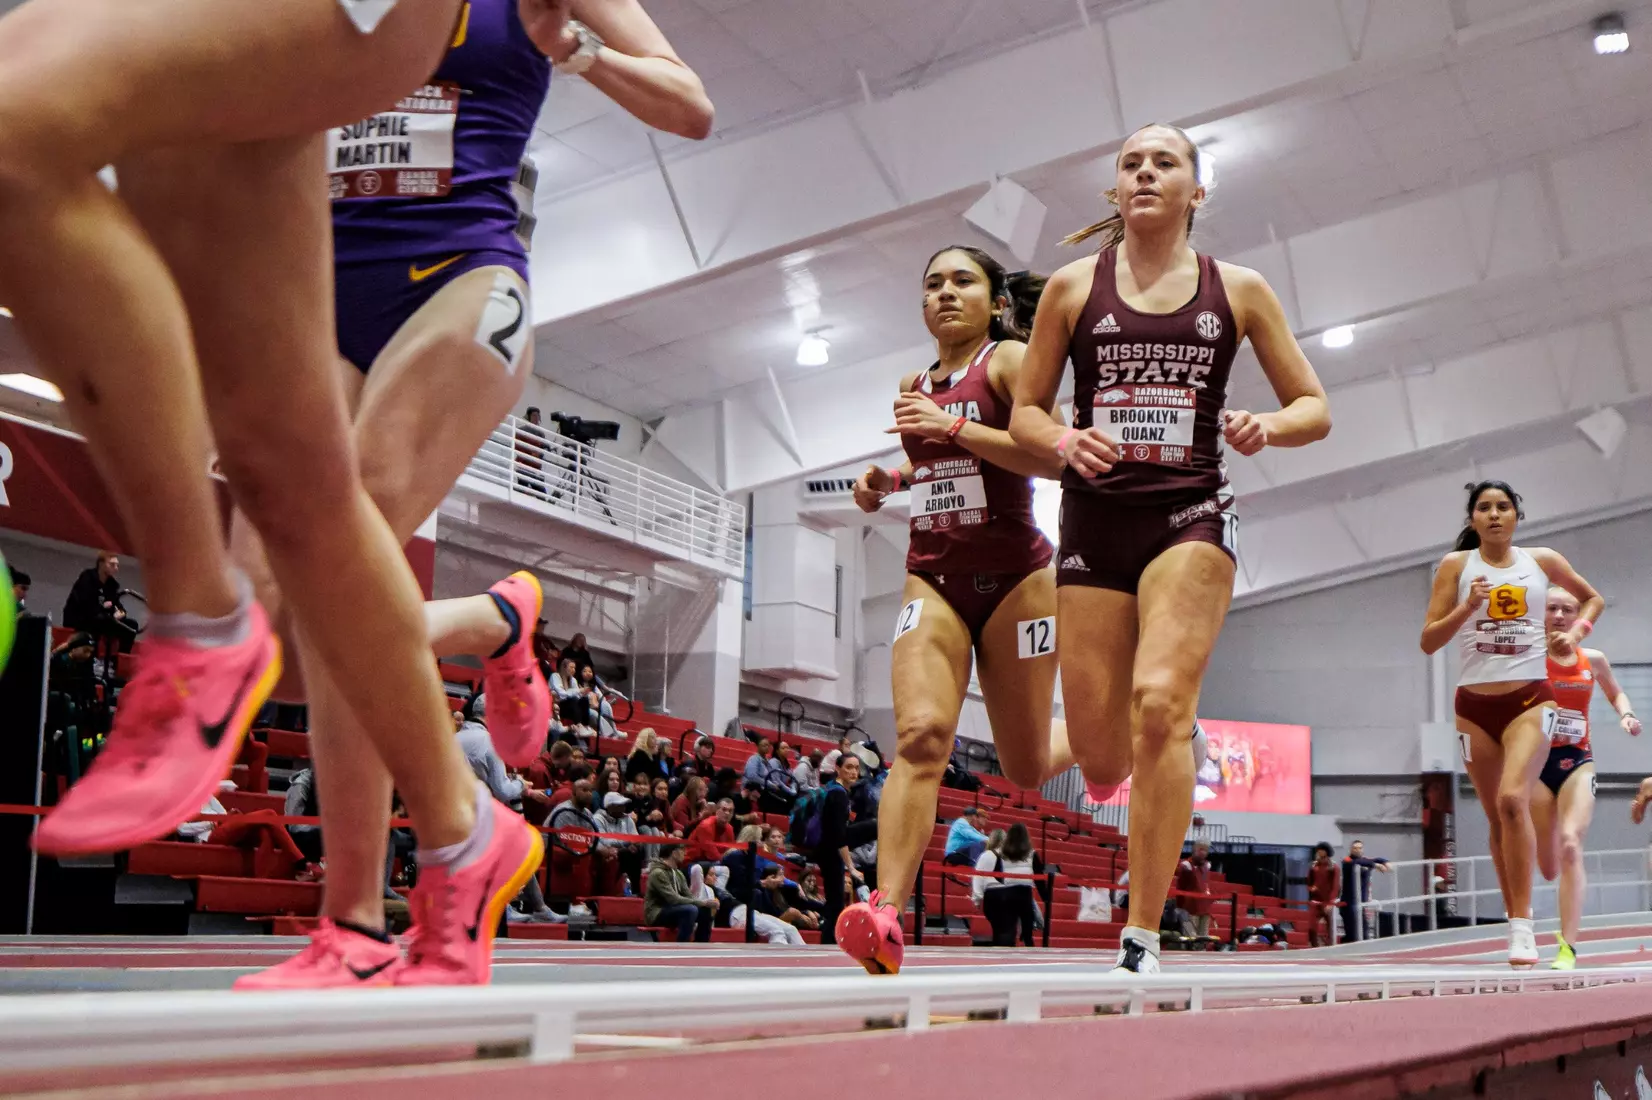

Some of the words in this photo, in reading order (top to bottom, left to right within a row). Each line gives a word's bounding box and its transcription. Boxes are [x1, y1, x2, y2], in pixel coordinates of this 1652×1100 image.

[341, 115, 410, 141] SOPHIE
[336, 142, 411, 168] MARTIN
[1092, 325, 1121, 335] adidas
[1198, 313, 1220, 338] SEC
[1096, 343, 1215, 365] MISSISSIPPI
[1098, 360, 1211, 389] STATE
[1134, 395, 1193, 406] INVITATIONAL
[1135, 387, 1186, 398] RAZORBACK
[1110, 409, 1178, 424] BROOKLYN
[1122, 426, 1165, 442] QUANZ
[934, 459, 973, 470] RAZORBACK
[934, 466, 978, 478] INVITATIONAL
[931, 480, 956, 496] ANYA
[925, 494, 966, 512] ARROYO
[1496, 589, 1519, 615] SC
[1026, 619, 1050, 655] 12
[1494, 636, 1516, 644] LOPEZ
[560, 832, 586, 843] SECTION
